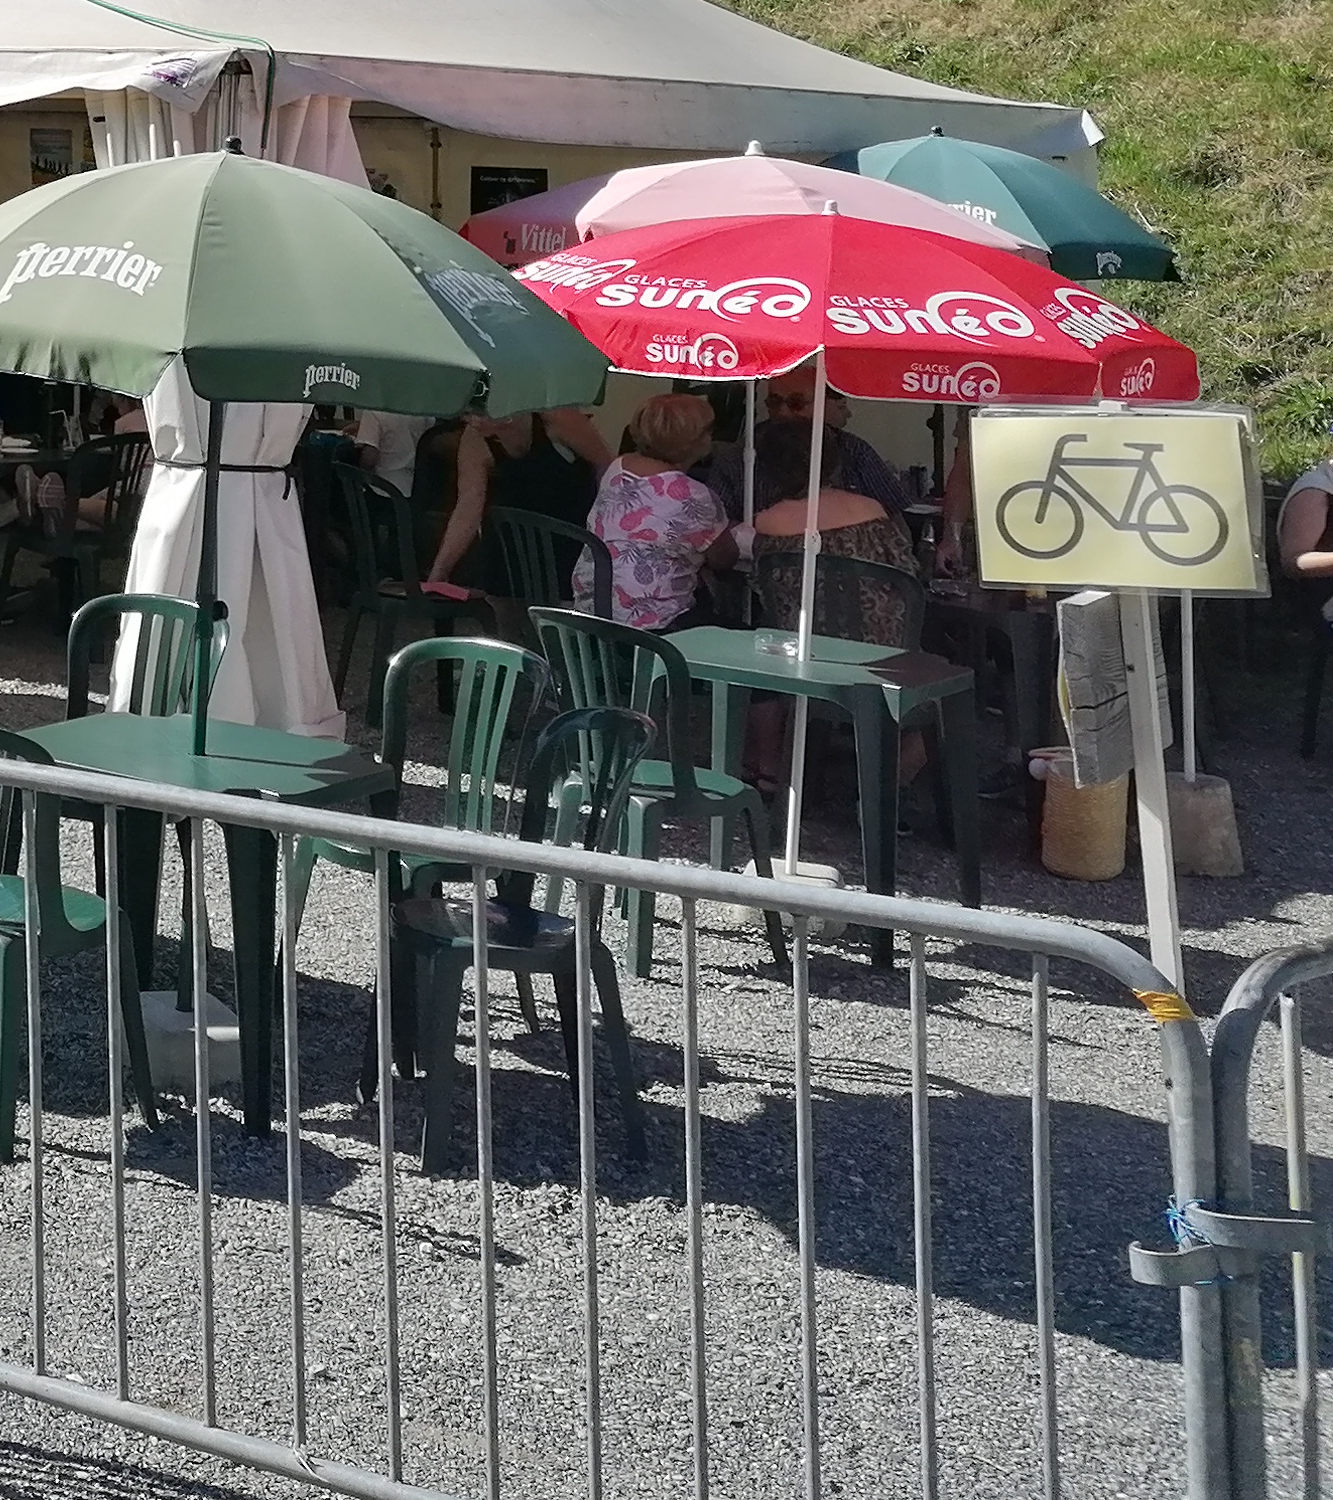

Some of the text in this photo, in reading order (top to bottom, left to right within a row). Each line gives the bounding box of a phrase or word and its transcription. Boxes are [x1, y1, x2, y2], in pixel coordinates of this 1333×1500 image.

[521, 223, 567, 253] Vittel
[624, 274, 708, 289] GLACES
[828, 294, 910, 309] GLACES
[910, 362, 951, 373] GLACES
